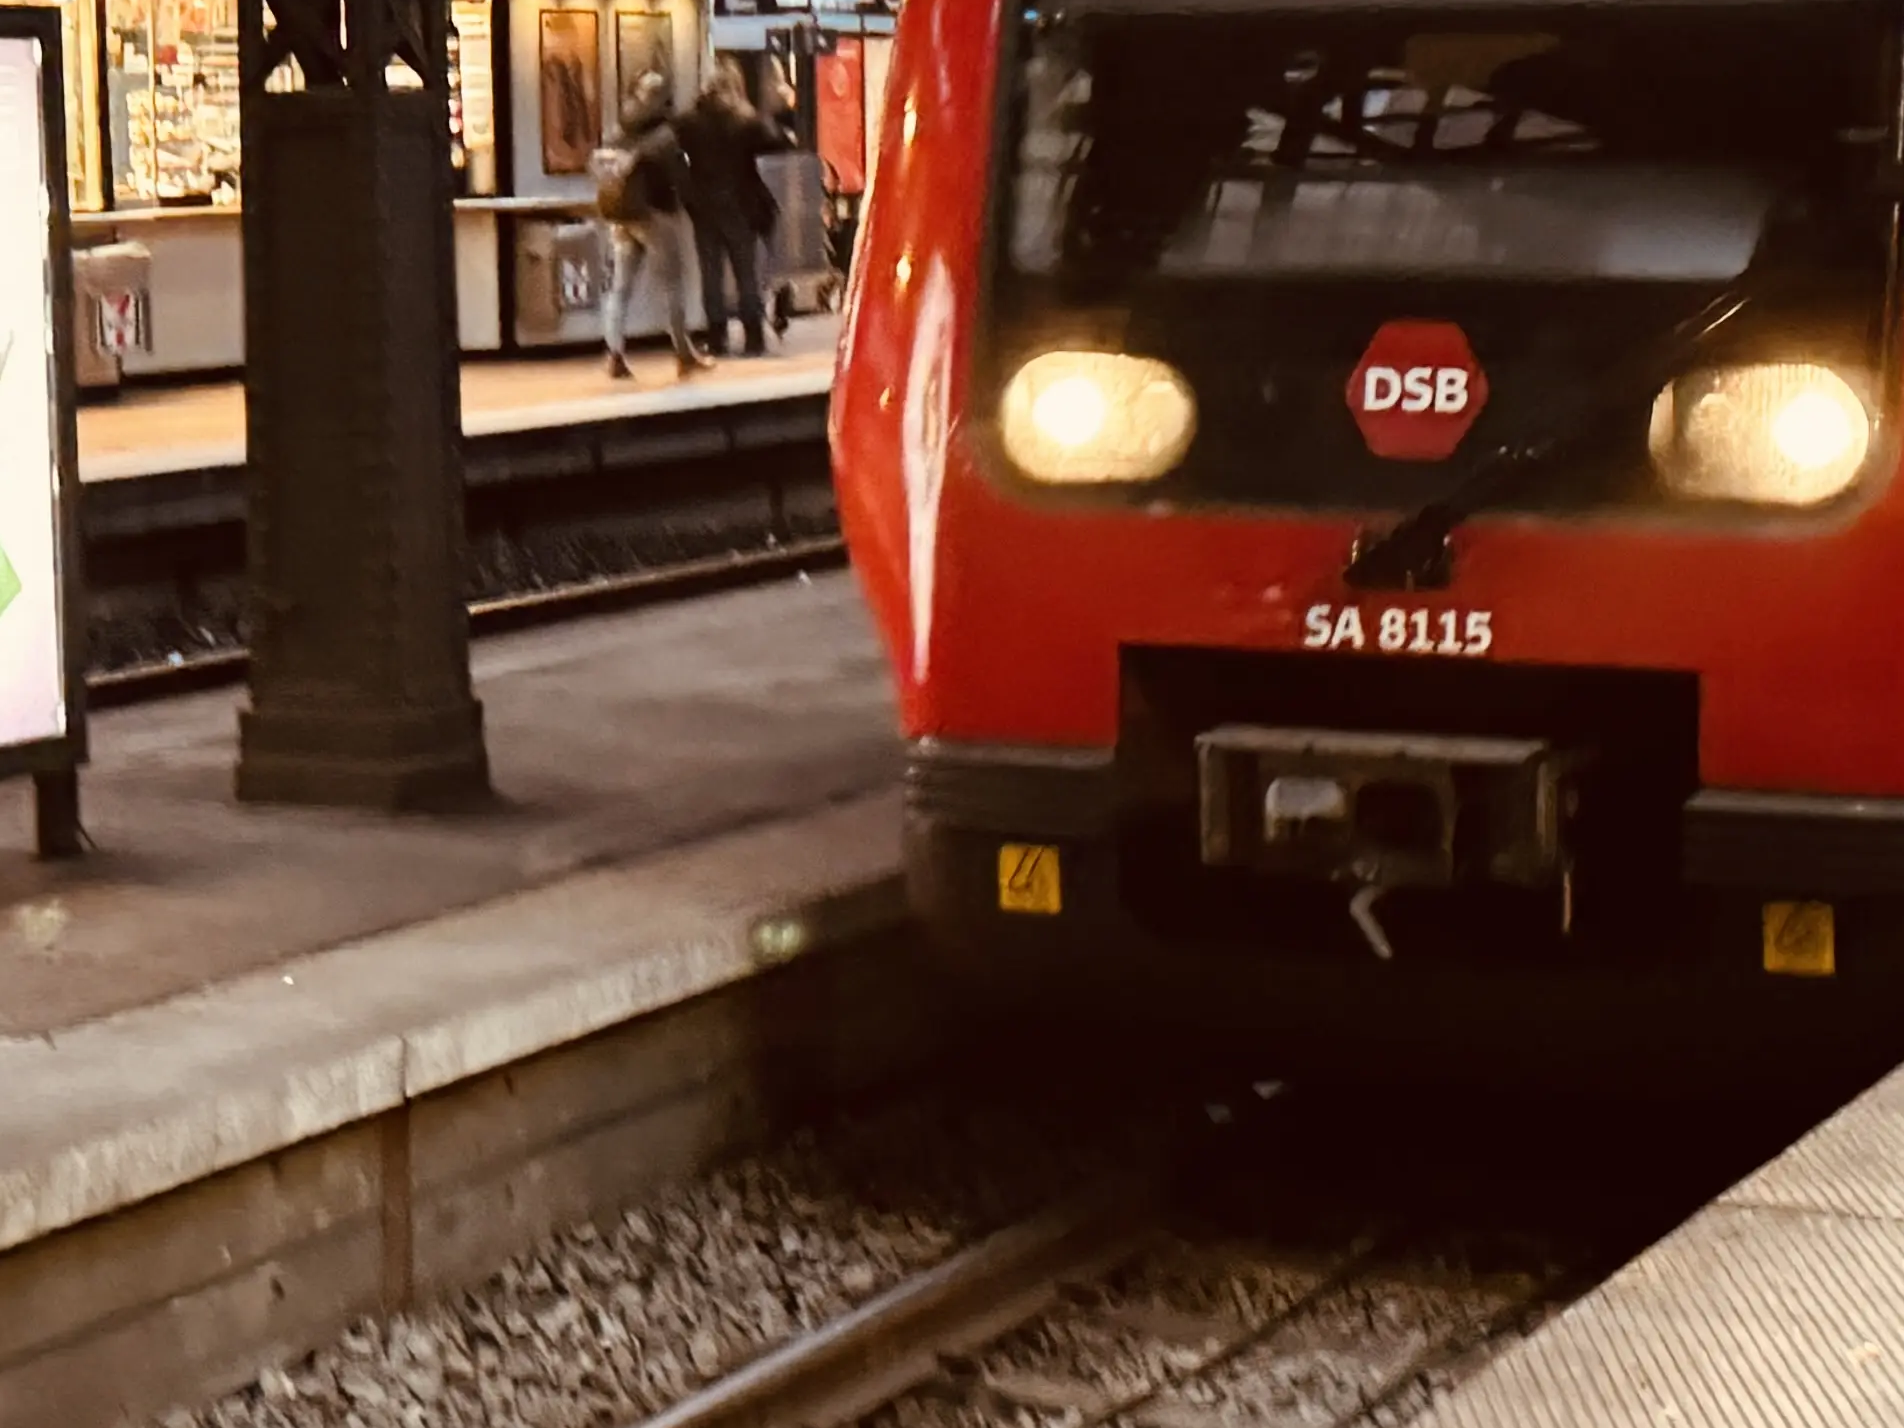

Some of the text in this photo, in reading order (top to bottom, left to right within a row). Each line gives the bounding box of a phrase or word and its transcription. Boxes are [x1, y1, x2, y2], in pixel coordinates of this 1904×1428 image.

[1363, 365, 1469, 413] DSB
[1304, 603, 1493, 657] SA 8115
